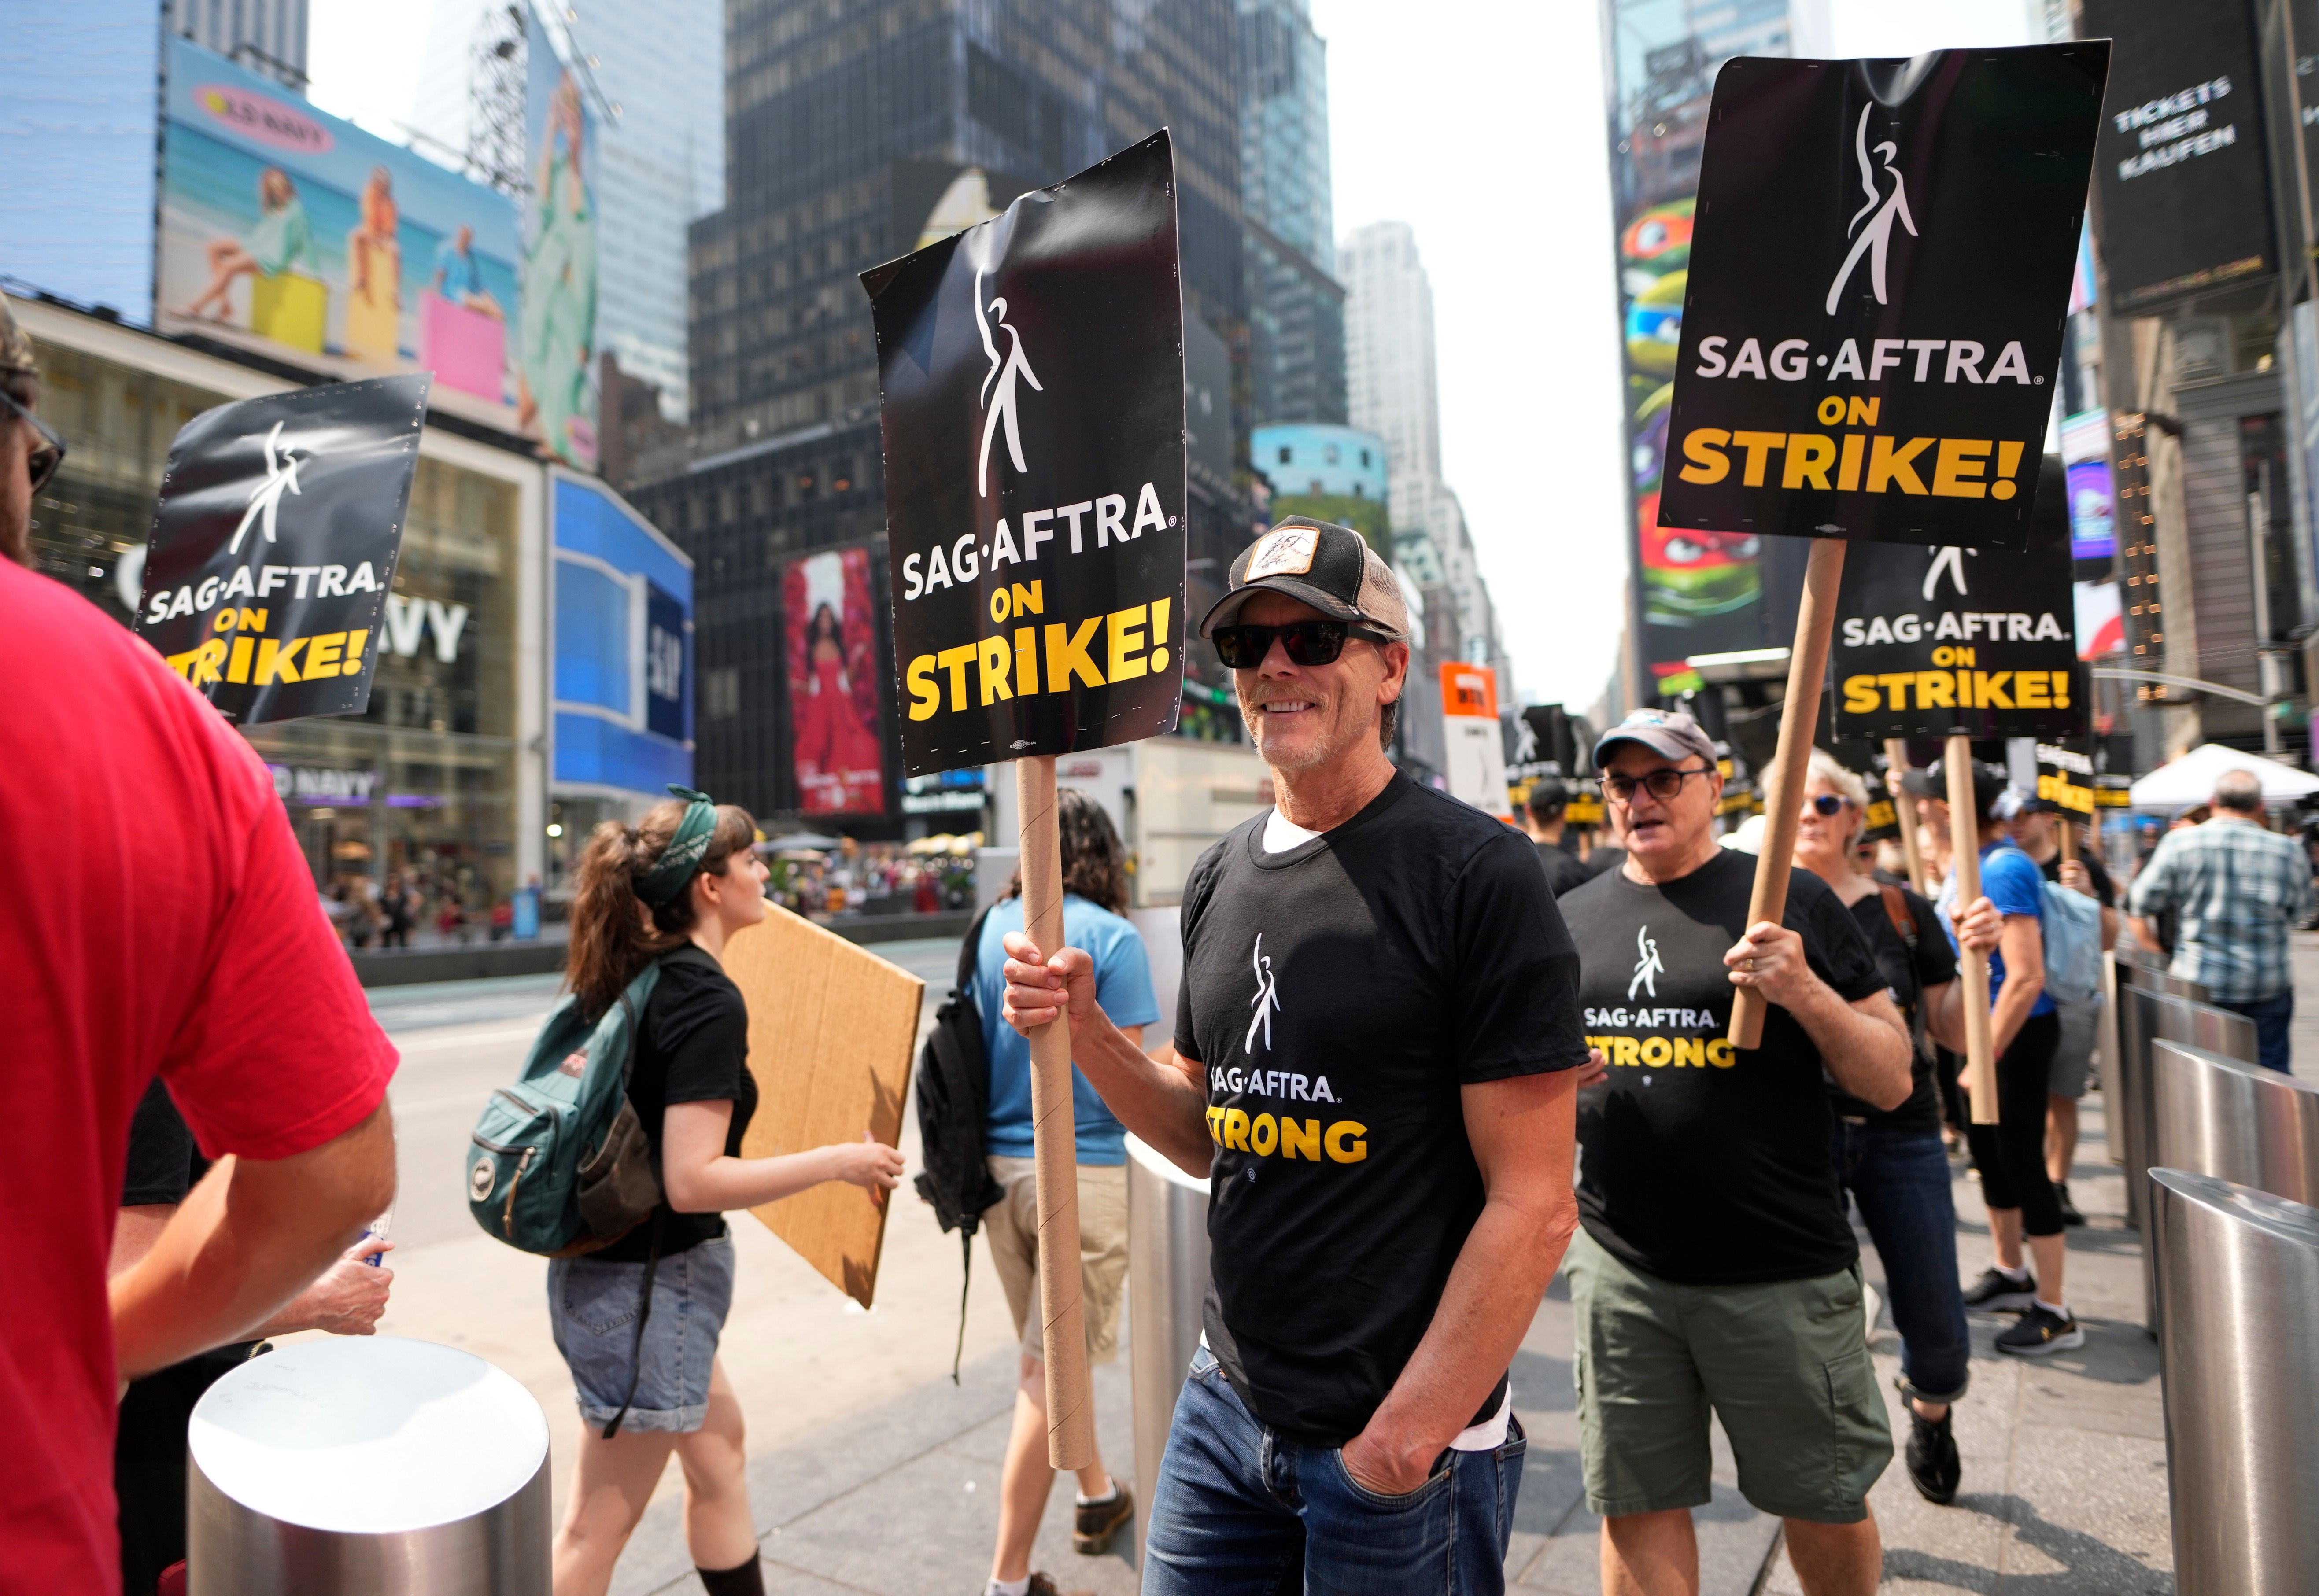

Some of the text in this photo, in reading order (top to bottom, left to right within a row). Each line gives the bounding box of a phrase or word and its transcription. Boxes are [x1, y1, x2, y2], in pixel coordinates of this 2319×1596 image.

[1817, 395, 1880, 426] ON
[1679, 427, 2025, 500] STRIKE!
[213, 608, 268, 633] ON
[990, 579, 1044, 623] ON
[377, 592, 469, 663] VY
[166, 629, 369, 688] TRIKE!
[906, 597, 1171, 721] STRIKE!
[1931, 645, 1976, 668] ON
[1843, 670, 2071, 714] STRIKE!
